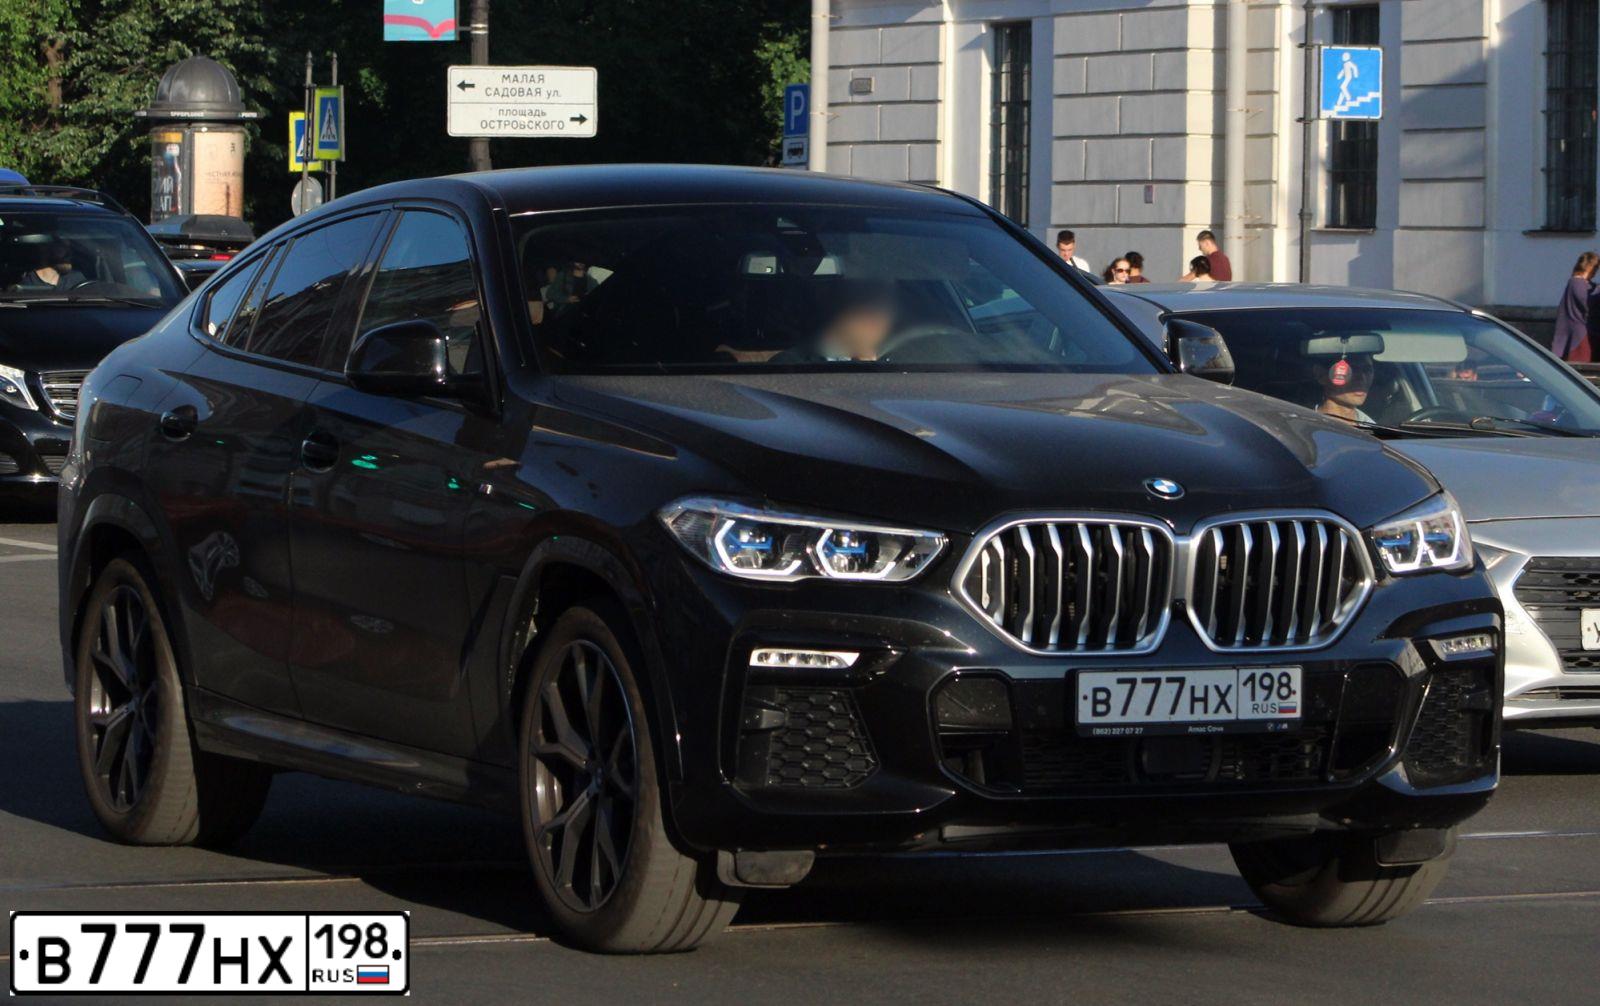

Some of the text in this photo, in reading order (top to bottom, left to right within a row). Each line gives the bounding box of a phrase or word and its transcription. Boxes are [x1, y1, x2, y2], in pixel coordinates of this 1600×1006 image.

[501, 73, 545, 84] МАЛАЯ
[484, 87, 562, 100] САДОВАЯ ул.
[498, 108, 547, 118] площадь
[790, 90, 805, 131] P
[480, 119, 565, 130] ОСТРОВСКОГО
[1242, 671, 1292, 702] 198
[1251, 702, 1277, 715] RUS
